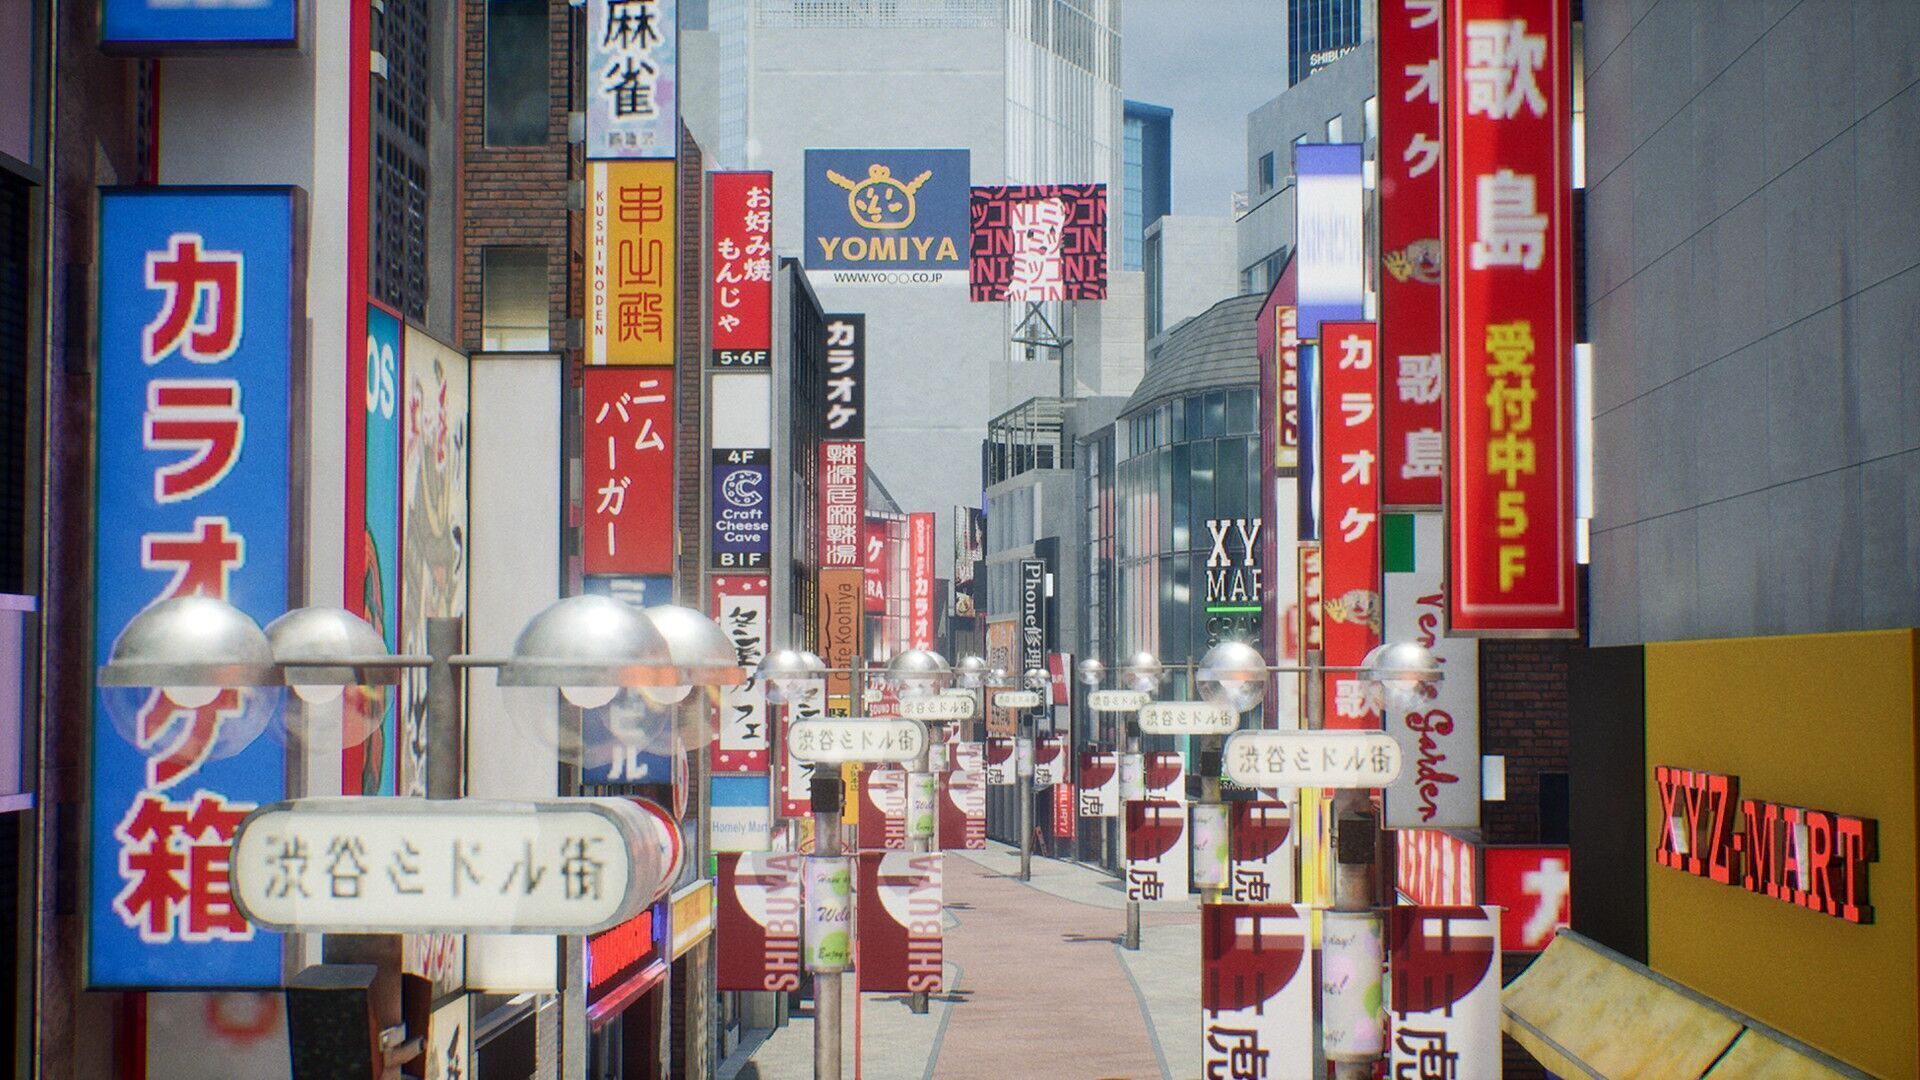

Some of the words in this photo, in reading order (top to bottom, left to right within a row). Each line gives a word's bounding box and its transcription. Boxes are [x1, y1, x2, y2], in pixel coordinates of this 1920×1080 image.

[604, 0, 657, 118] 麻雀
[1465, 19, 1549, 270] 歌島
[594, 190, 605, 336] KUSHINODEN
[744, 186, 772, 283] お好み焼
[817, 236, 960, 262] YOMIYA
[716, 237, 741, 334] もんじゃ
[827, 320, 857, 430] カラオケ
[595, 392, 632, 556] バーガー
[727, 450, 756, 464] 4F
[1339, 333, 1377, 544] カラオケ
[1484, 319, 1538, 593] 受付中5F
[715, 520, 769, 532] Cheese
[721, 509, 763, 520] Craft
[723, 532, 762, 543] Cave
[1206, 518, 1262, 567] XY
[798, 728, 915, 753] 渋谷ミドル街
[1145, 709, 1233, 728] 渋谷ミドル街
[1238, 743, 1393, 774] 渋谷ミドル街
[885, 771, 906, 849] SHIBUYA
[965, 771, 987, 849] SHIBUYA
[1404, 709, 1460, 824] Garden
[264, 835, 606, 901] 渋谷ミドル街
[712, 820, 746, 836] Homely
[748, 820, 769, 833] Mart
[1655, 765, 1878, 925] XYZ-MART
[763, 853, 800, 993] SHIBUYA
[906, 853, 945, 993] SHIBUYA
